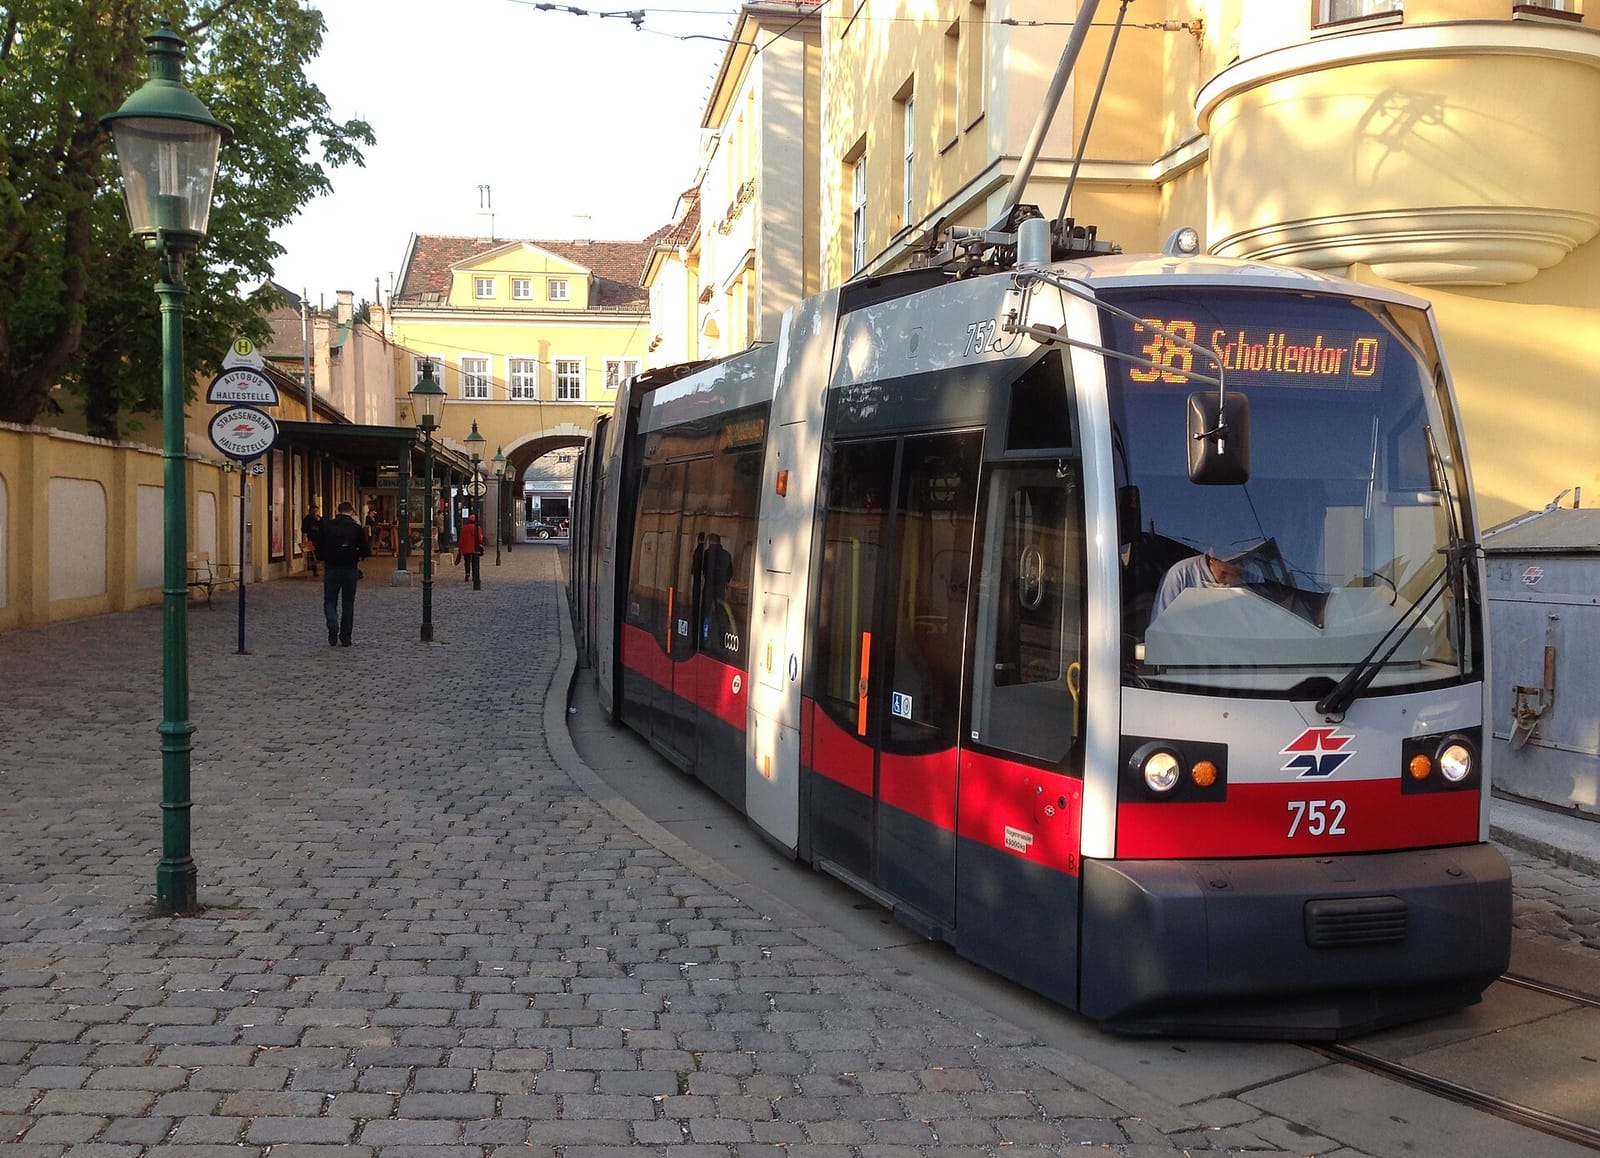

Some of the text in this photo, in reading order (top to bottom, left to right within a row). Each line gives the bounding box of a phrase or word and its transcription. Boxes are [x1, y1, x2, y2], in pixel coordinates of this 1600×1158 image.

[963, 319, 996, 357] 752
[238, 341, 248, 353] H
[1129, 318, 1197, 384] 38
[1209, 330, 1349, 375] Schottentor
[224, 373, 264, 386] AUTOBUS
[216, 392, 270, 401] HALTESTELLE
[217, 412, 270, 431] STRASSENBAHN
[219, 437, 268, 453] HALTESTELLE
[254, 464, 265, 473] 38
[1287, 799, 1346, 838] 752
[1068, 853, 1075, 870] B
